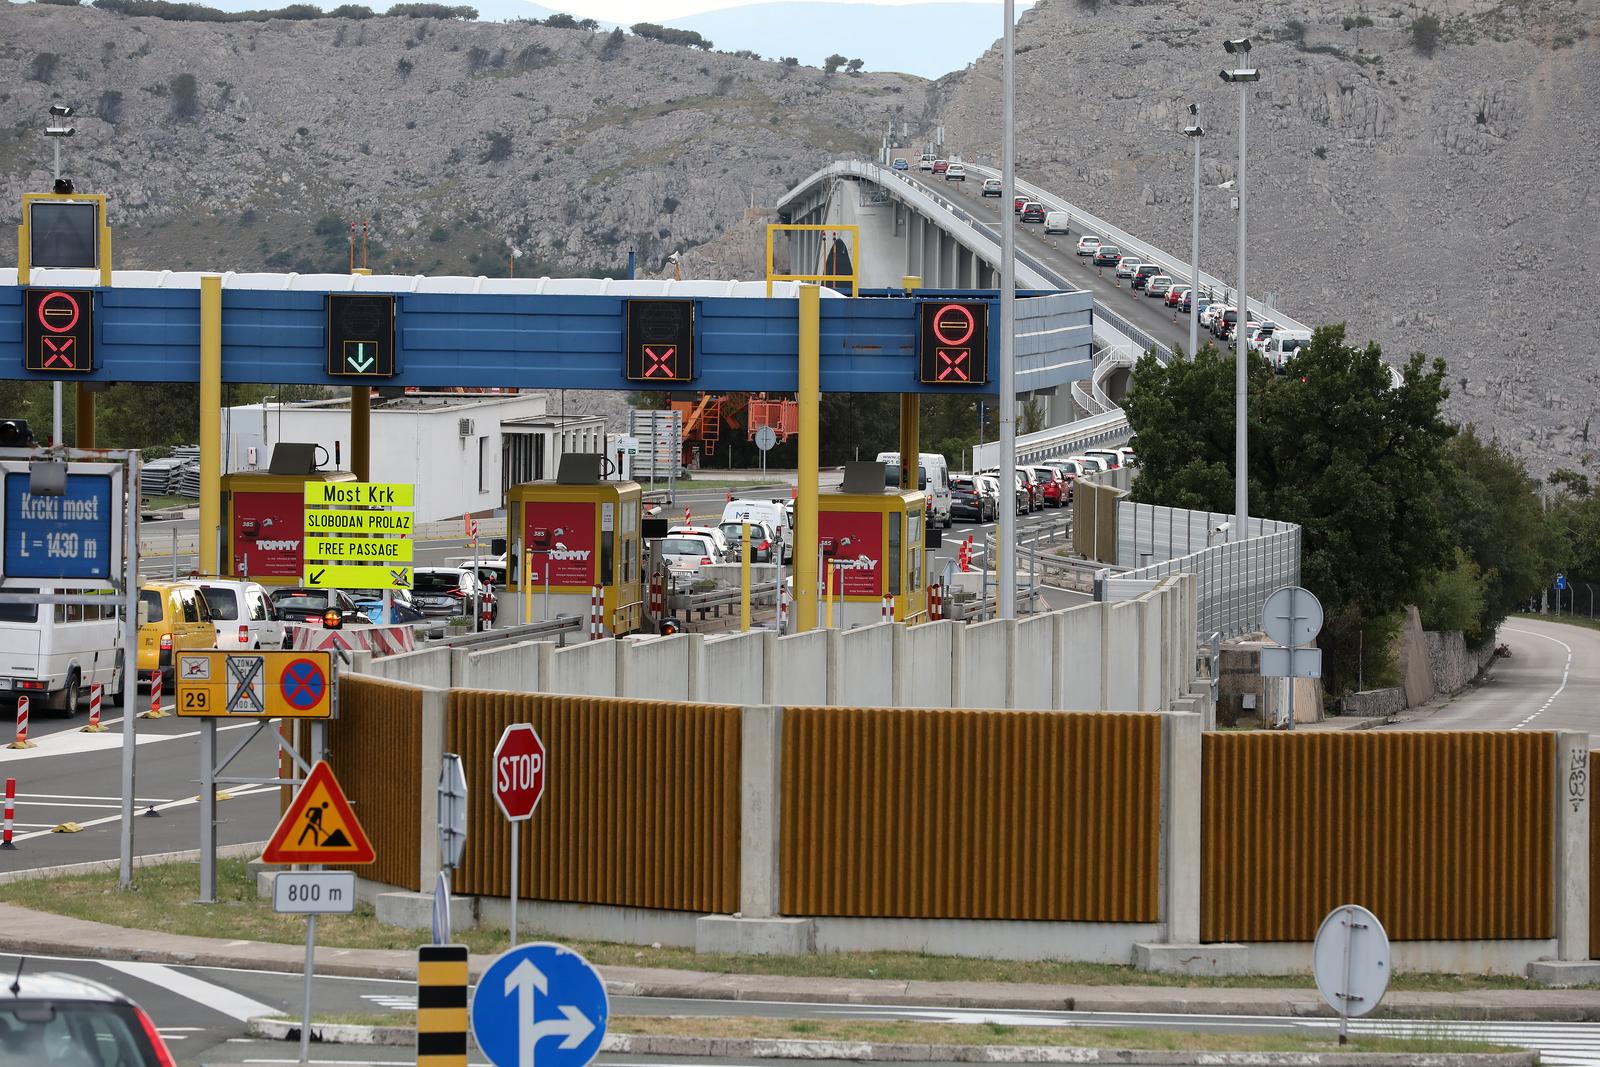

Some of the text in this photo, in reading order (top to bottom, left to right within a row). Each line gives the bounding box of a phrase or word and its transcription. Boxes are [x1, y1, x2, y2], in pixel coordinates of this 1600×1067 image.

[324, 485, 395, 503] Most Krk
[62, 495, 98, 520] most
[308, 514, 410, 529] SLOBODAN PROLAZ
[20, 531, 30, 557] L
[46, 532, 79, 558] 1430
[83, 538, 97, 559] m
[255, 540, 300, 551] TOMMY
[318, 542, 399, 557] FREE PASSAGE
[186, 692, 206, 708] 29
[499, 753, 541, 793] STOP
[288, 884, 342, 901] 800 m
